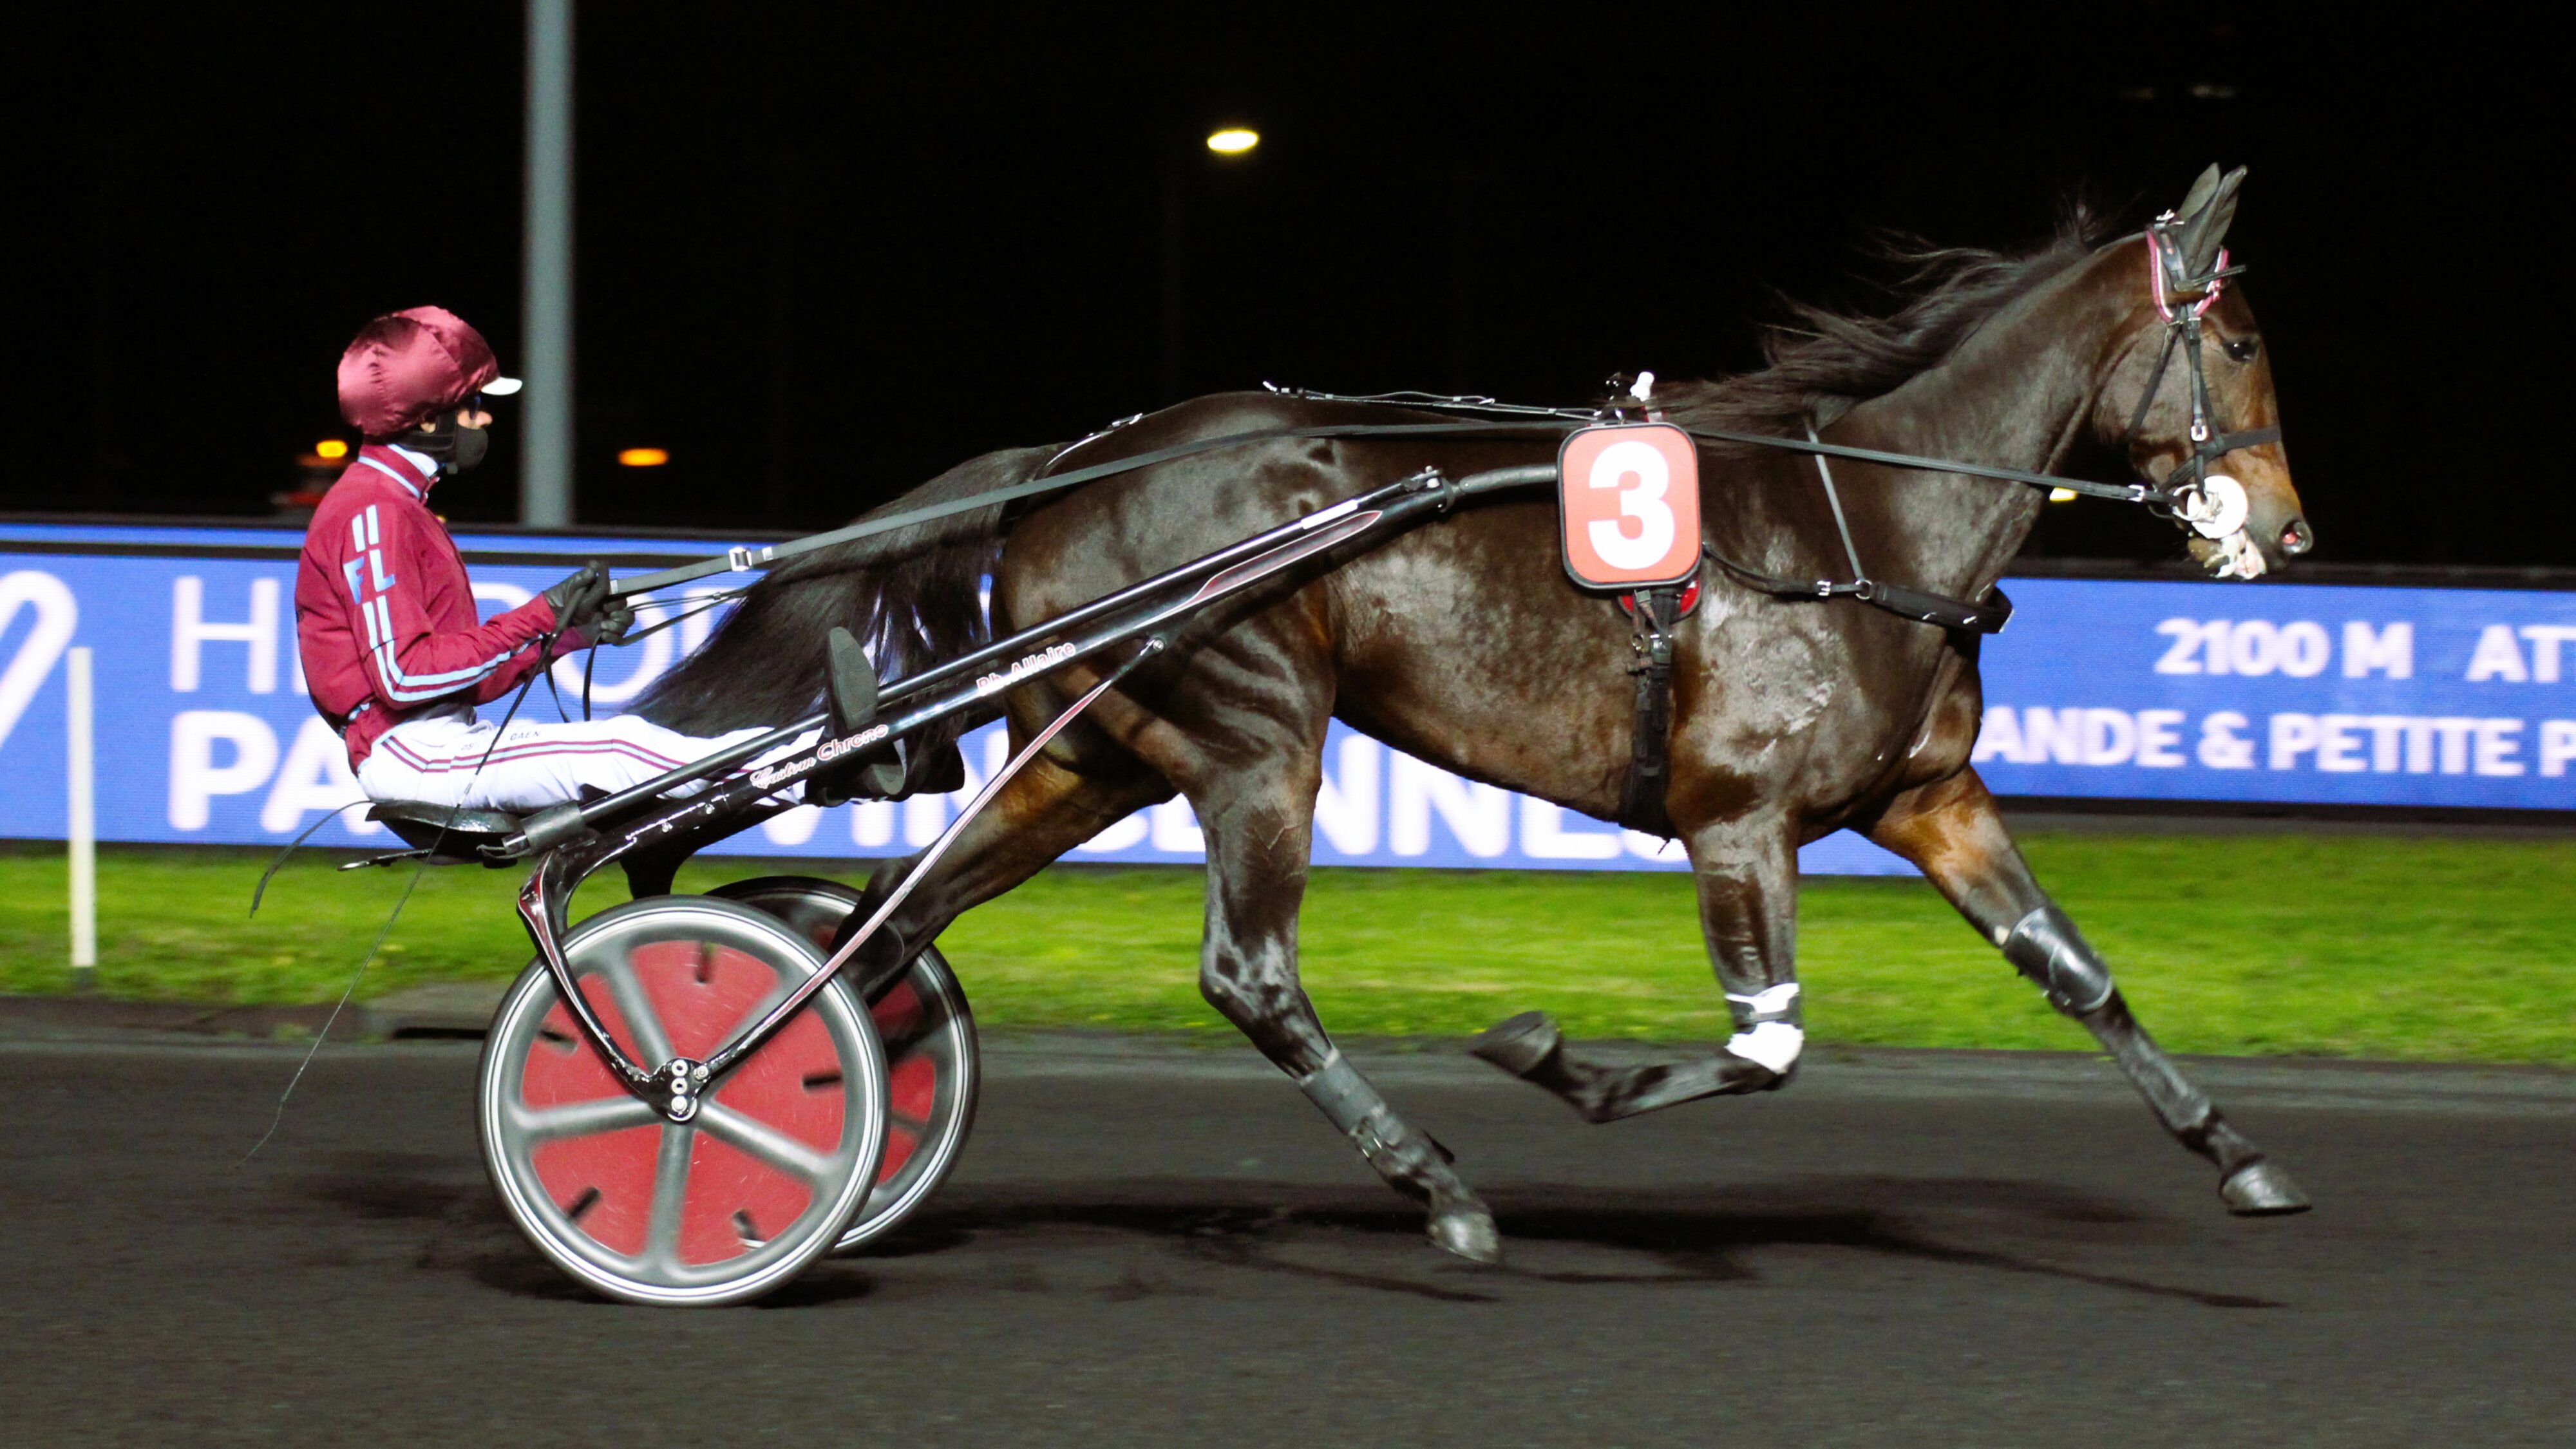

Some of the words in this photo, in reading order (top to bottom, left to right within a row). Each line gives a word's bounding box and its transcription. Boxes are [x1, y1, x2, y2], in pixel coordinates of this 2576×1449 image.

[1587, 441, 1674, 570] 3
[343, 549, 395, 605] FL
[1011, 643, 1075, 676] Allaire
[2154, 618, 2331, 677] 2100
[2342, 621, 2414, 679] M
[2465, 625, 2576, 683] AT
[750, 757, 817, 789] Custom
[817, 724, 889, 761] Chrono
[1969, 705, 2187, 767] ANDE
[2196, 711, 2255, 769] &
[2268, 713, 2524, 775] PETITE
